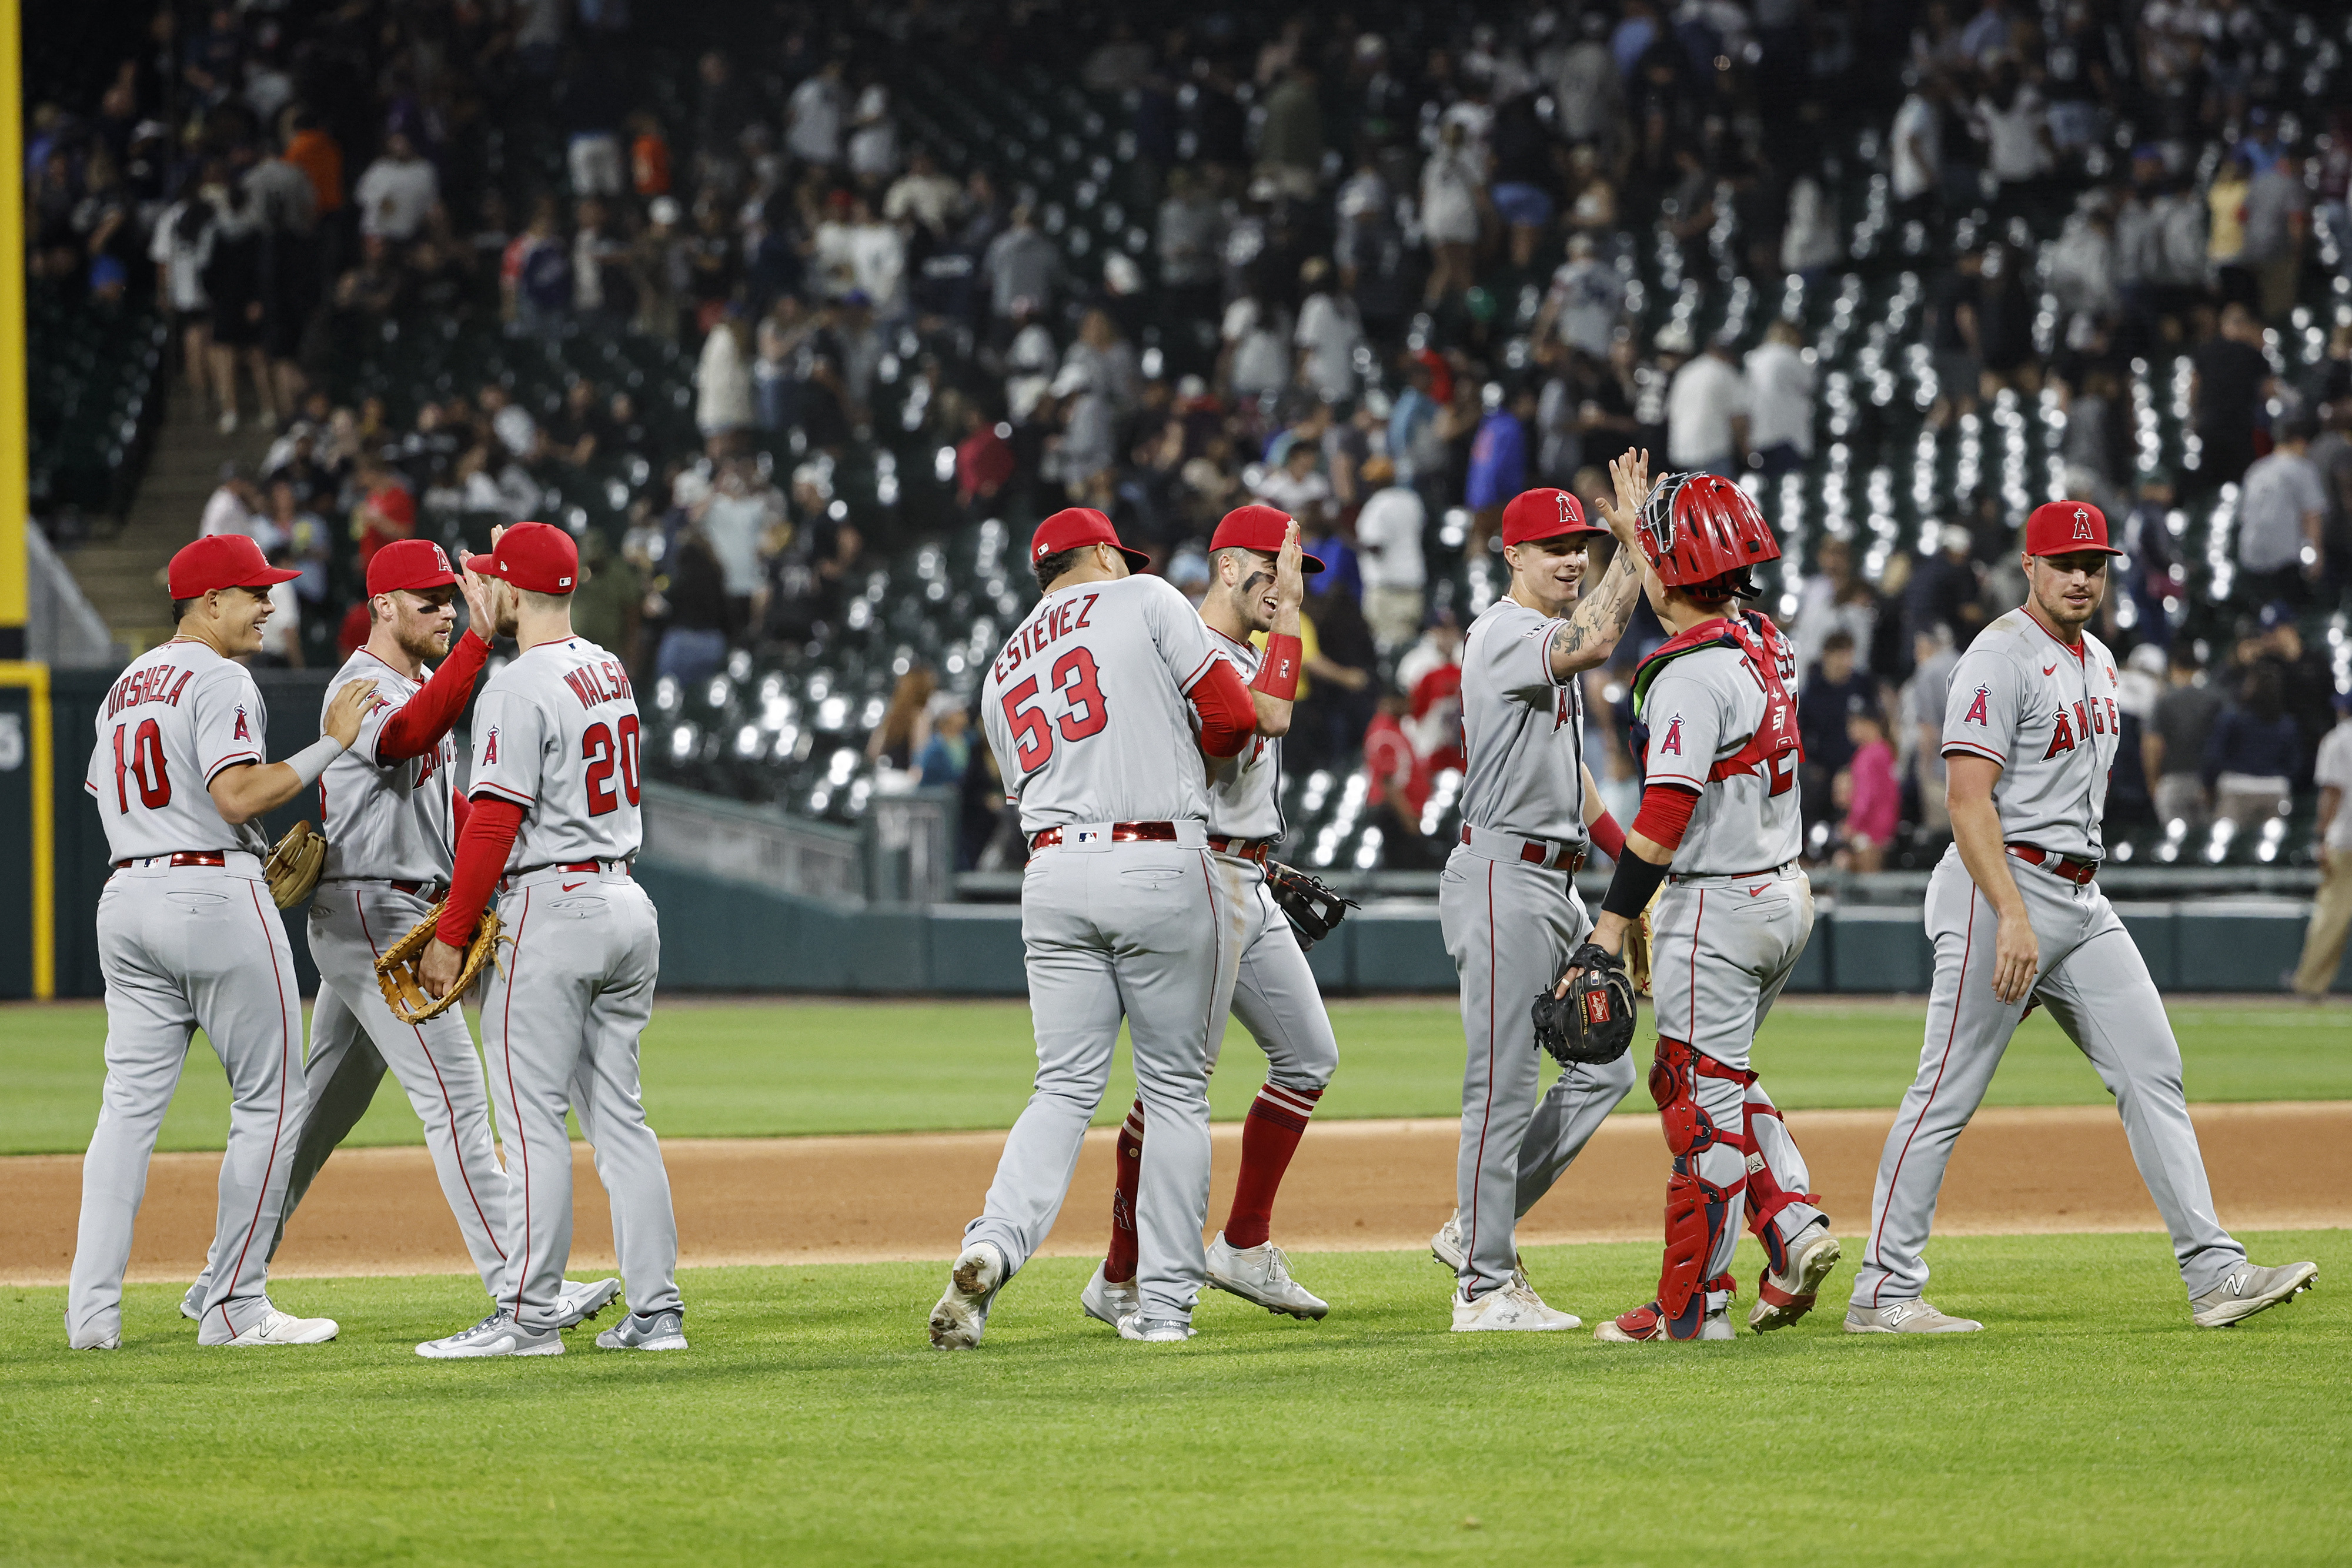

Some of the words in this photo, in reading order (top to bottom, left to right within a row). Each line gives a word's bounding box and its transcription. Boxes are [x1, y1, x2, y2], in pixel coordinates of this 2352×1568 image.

[1556, 492, 1579, 523] A
[2072, 508, 2094, 540] A
[994, 593, 1100, 686] ESTÉVEZ
[108, 664, 194, 721] URSHELA
[563, 661, 632, 710] WALSH
[1962, 680, 1992, 728] A
[233, 701, 253, 745] A
[1001, 646, 1108, 774] 53
[1659, 710, 1686, 757] A
[2039, 694, 2119, 764] ANGE
[113, 718, 172, 815] 10
[482, 722, 500, 767] A
[582, 713, 640, 817] 20
[1592, 994, 1604, 1019] Rawlings
